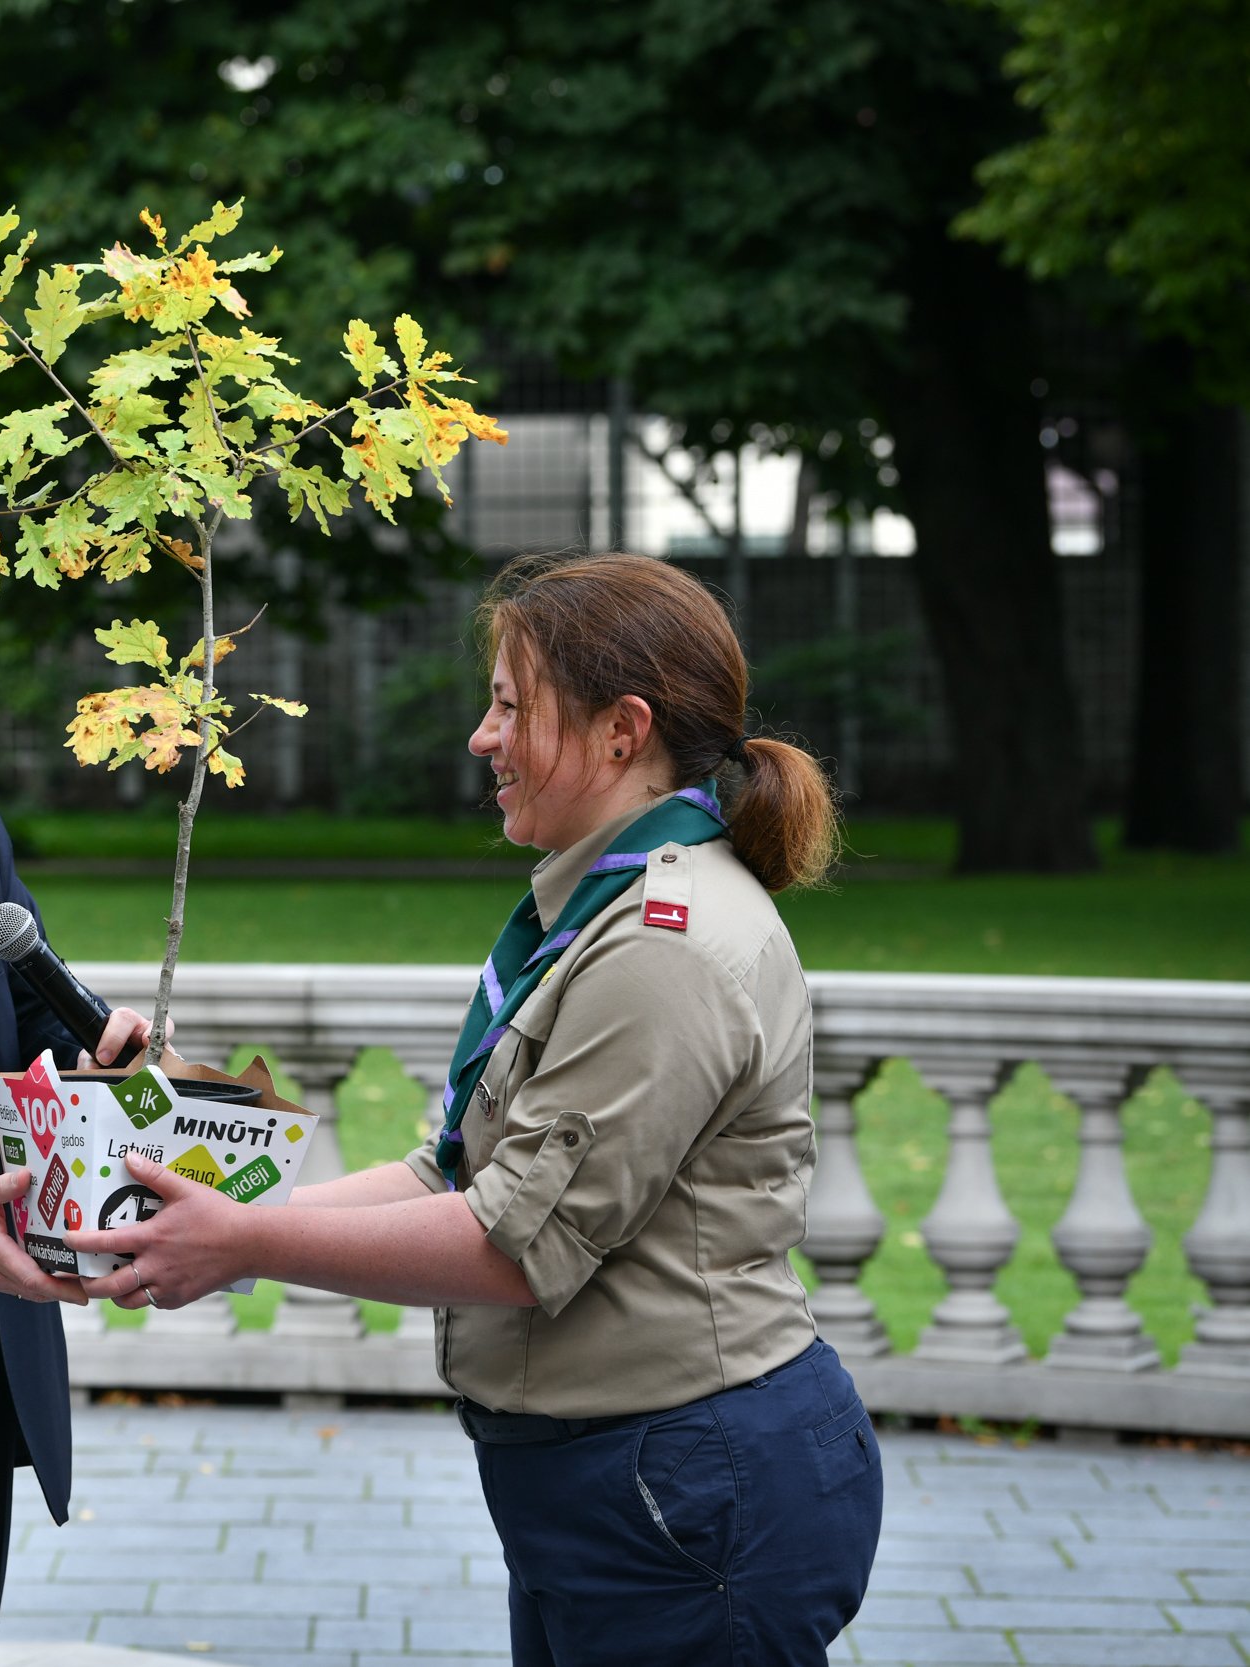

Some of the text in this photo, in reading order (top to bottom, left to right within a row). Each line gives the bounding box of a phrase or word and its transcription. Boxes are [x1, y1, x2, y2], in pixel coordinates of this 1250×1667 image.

[649, 909, 684, 922] 1
[139, 1087, 159, 1111] ik
[20, 1095, 62, 1137] 100
[61, 1133, 85, 1149] gados
[40, 1162, 65, 1221] Latvijā
[225, 1163, 270, 1201] vidēji
[69, 1203, 80, 1223] ir
